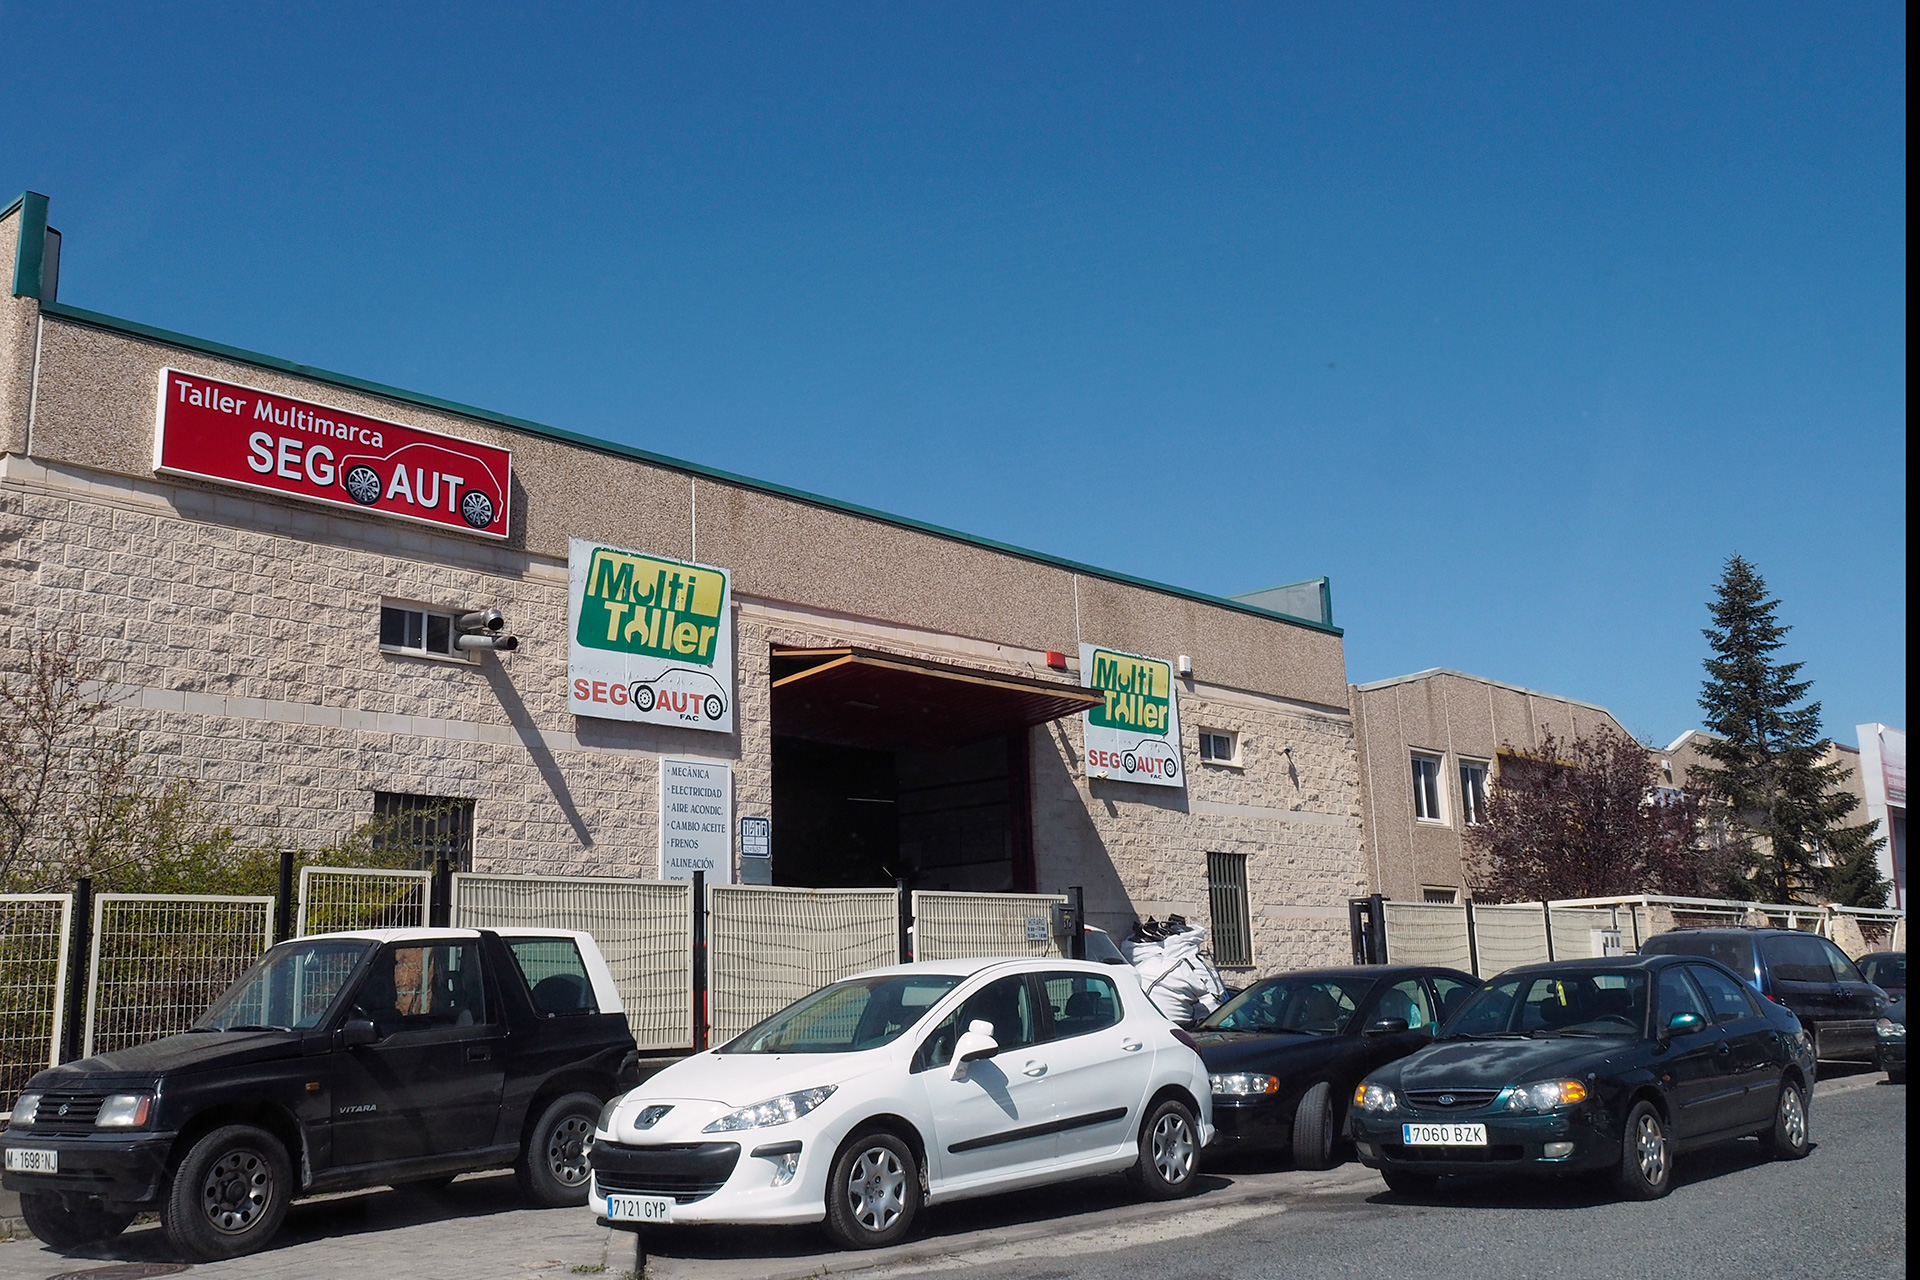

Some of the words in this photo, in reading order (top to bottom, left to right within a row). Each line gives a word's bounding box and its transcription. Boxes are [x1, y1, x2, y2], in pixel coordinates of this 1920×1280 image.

[174, 379, 247, 415] Taller
[253, 399, 384, 448] Multimarca
[594, 557, 697, 612] Multi
[604, 600, 716, 657] Taller
[1095, 657, 1154, 696] Multi
[1103, 690, 1168, 730] Taller
[679, 713, 700, 722] FAC
[671, 766, 710, 779] MECÁNICA
[671, 785, 723, 799] ELECTRICIDAD
[671, 803, 689, 813] AIRE
[690, 804, 724, 816] ACONDIC.
[670, 820, 700, 832] CAMBIO
[701, 823, 726, 834] ACEITE
[670, 838, 699, 849] FRENOS
[670, 857, 714, 869] ALINEACIÓN
[340, 1104, 377, 1114] VITARA
[1412, 1127, 1450, 1142] 7060
[1455, 1127, 1483, 1142] BZK
[614, 1199, 640, 1217] 7121
[644, 1201, 666, 1218] GYP
